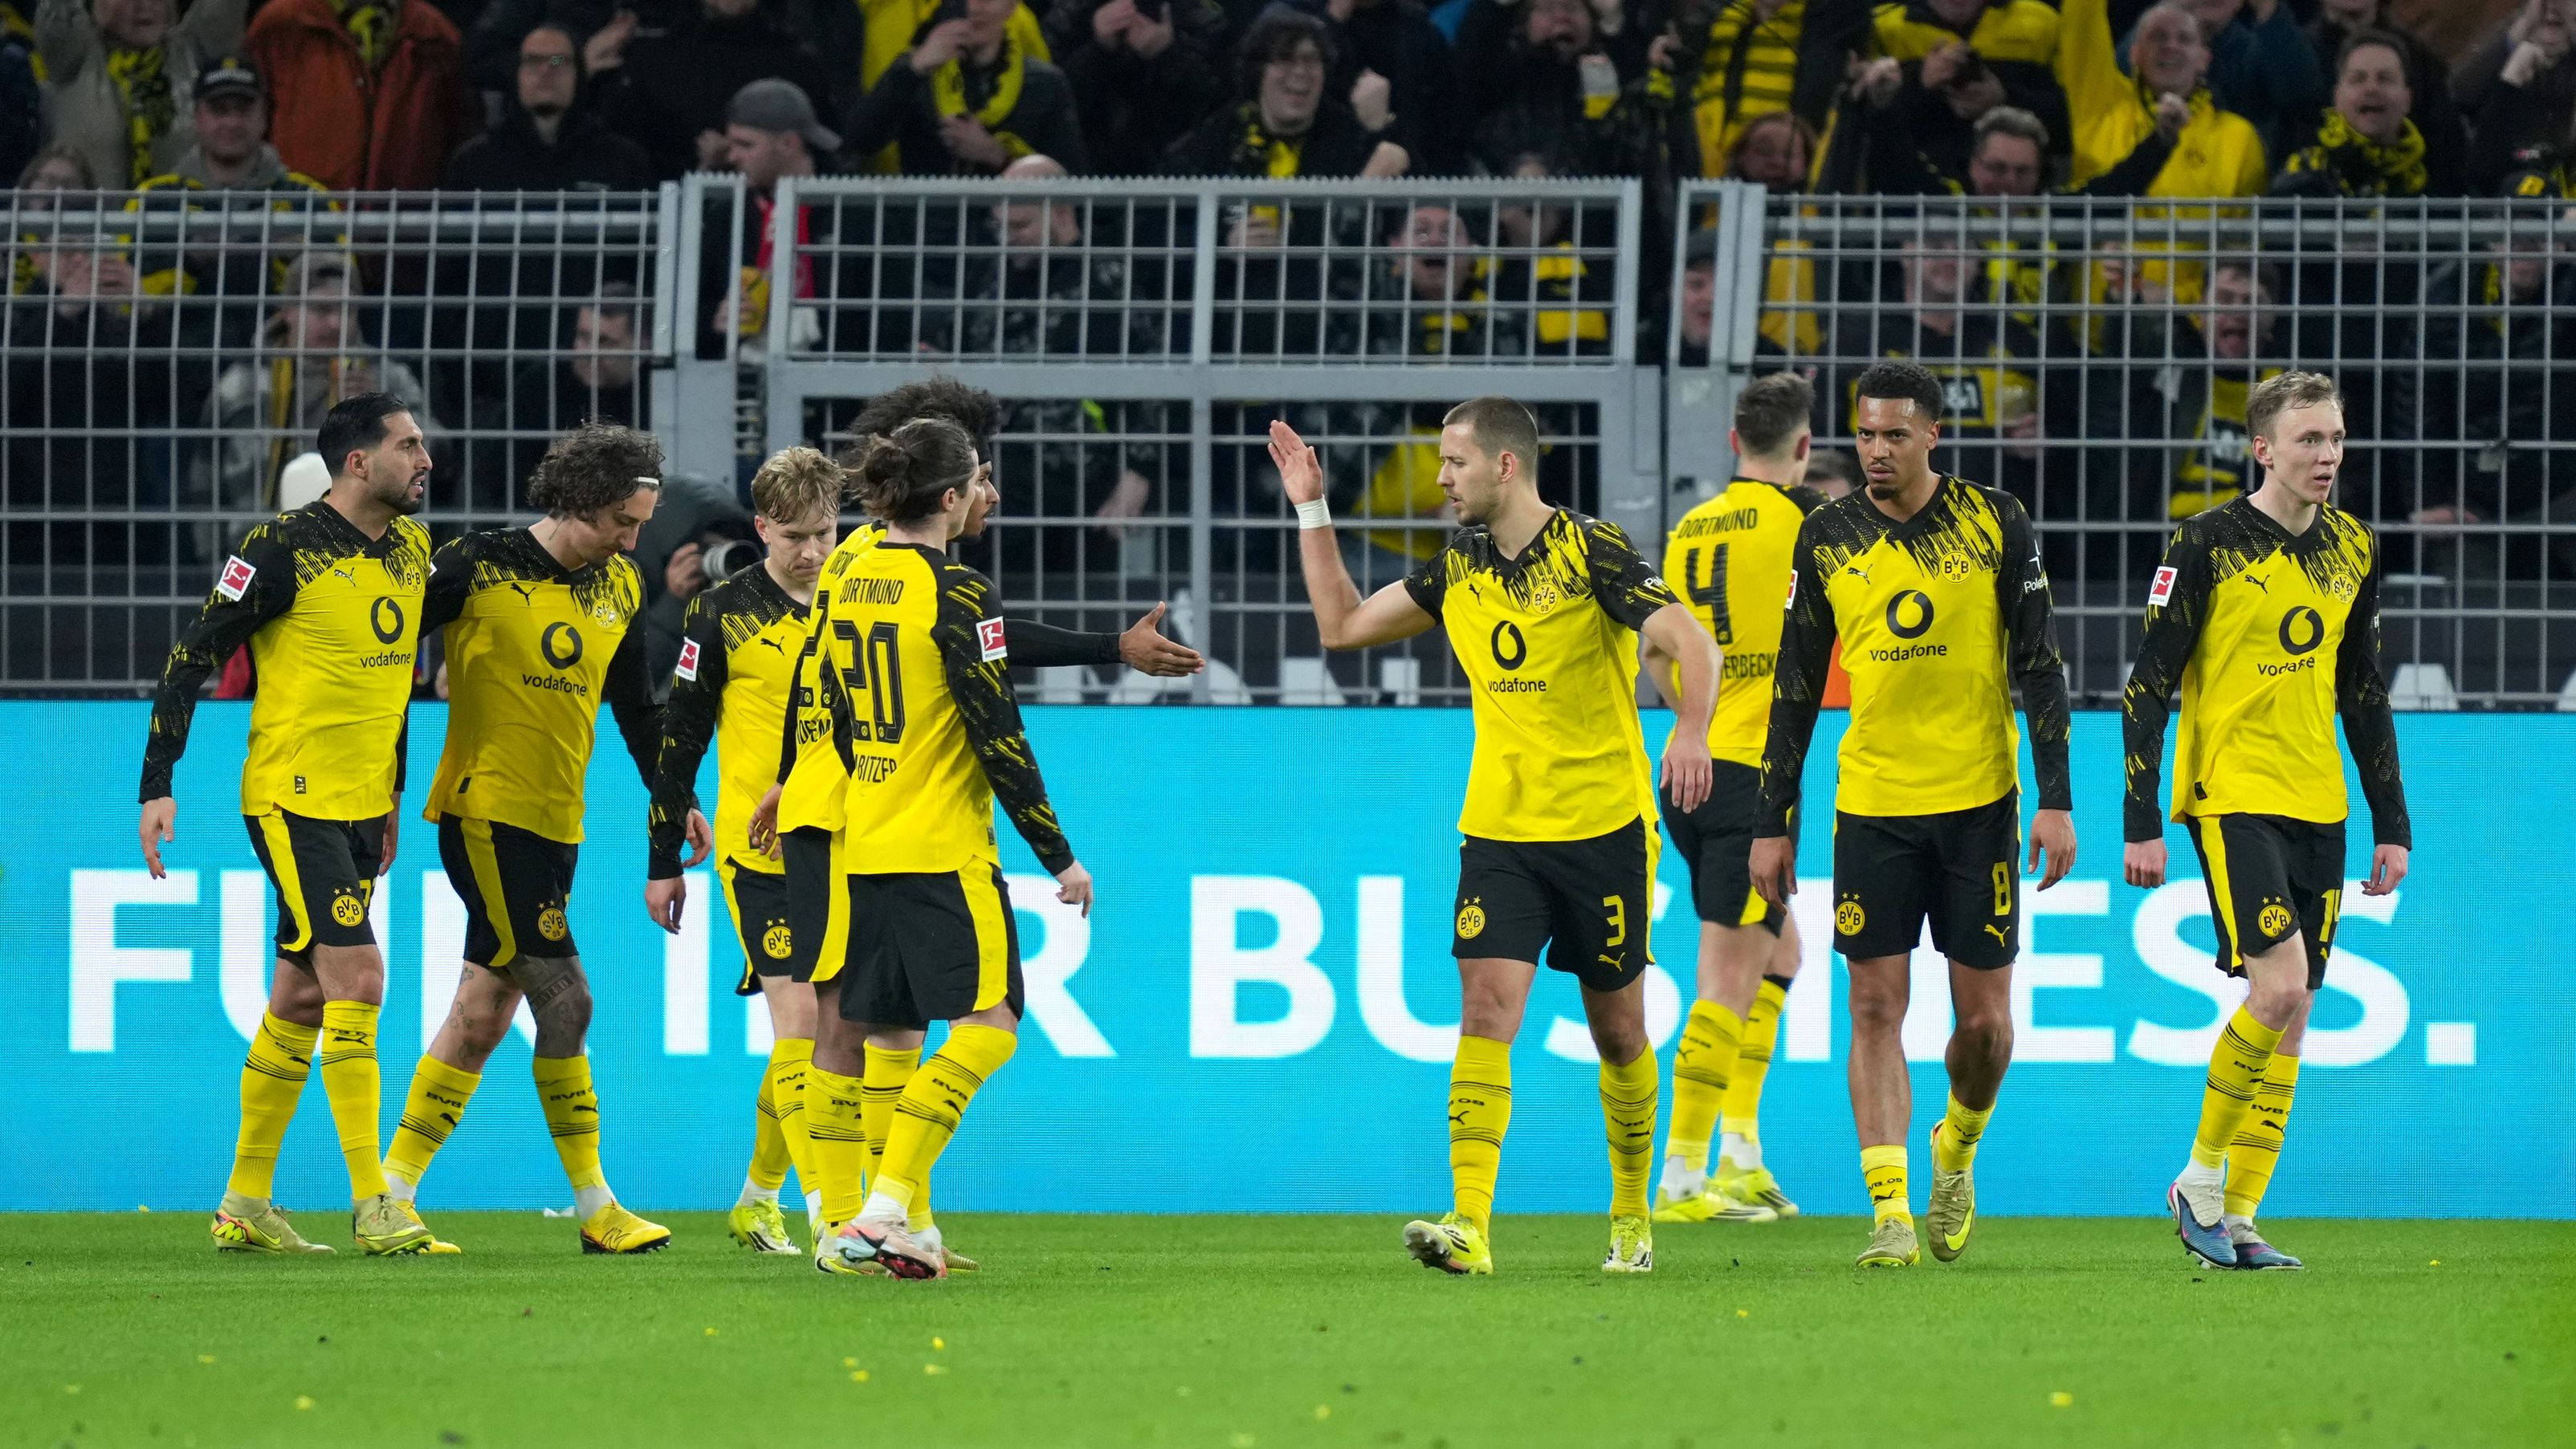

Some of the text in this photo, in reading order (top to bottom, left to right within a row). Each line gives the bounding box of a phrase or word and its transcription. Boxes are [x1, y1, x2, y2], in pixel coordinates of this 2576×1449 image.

[1677, 508, 1758, 539] DORTMUND
[1944, 554, 1968, 574] BVB
[406, 567, 421, 585] BVB
[1685, 543, 1734, 645] 4
[360, 650, 411, 669] vodafone
[1869, 642, 1947, 662] vodafone
[1724, 653, 1777, 679] ERBECK
[2257, 656, 2315, 677] vodafe
[523, 674, 587, 697] vodafone
[831, 619, 906, 745] 20
[1488, 677, 1547, 693] vodafone
[854, 753, 898, 784] BITZER
[1991, 861, 2011, 916] 8
[336, 898, 360, 918] BVB
[1839, 906, 1861, 926] BVB
[1461, 910, 1481, 930] BVB
[1603, 894, 1626, 947] 3
[2264, 909, 2288, 929] BVB
[768, 930, 792, 950] BVB
[663, 872, 1119, 1057] IR
[426, 1091, 462, 1109] BVB
[832, 1099, 862, 1107] BV
